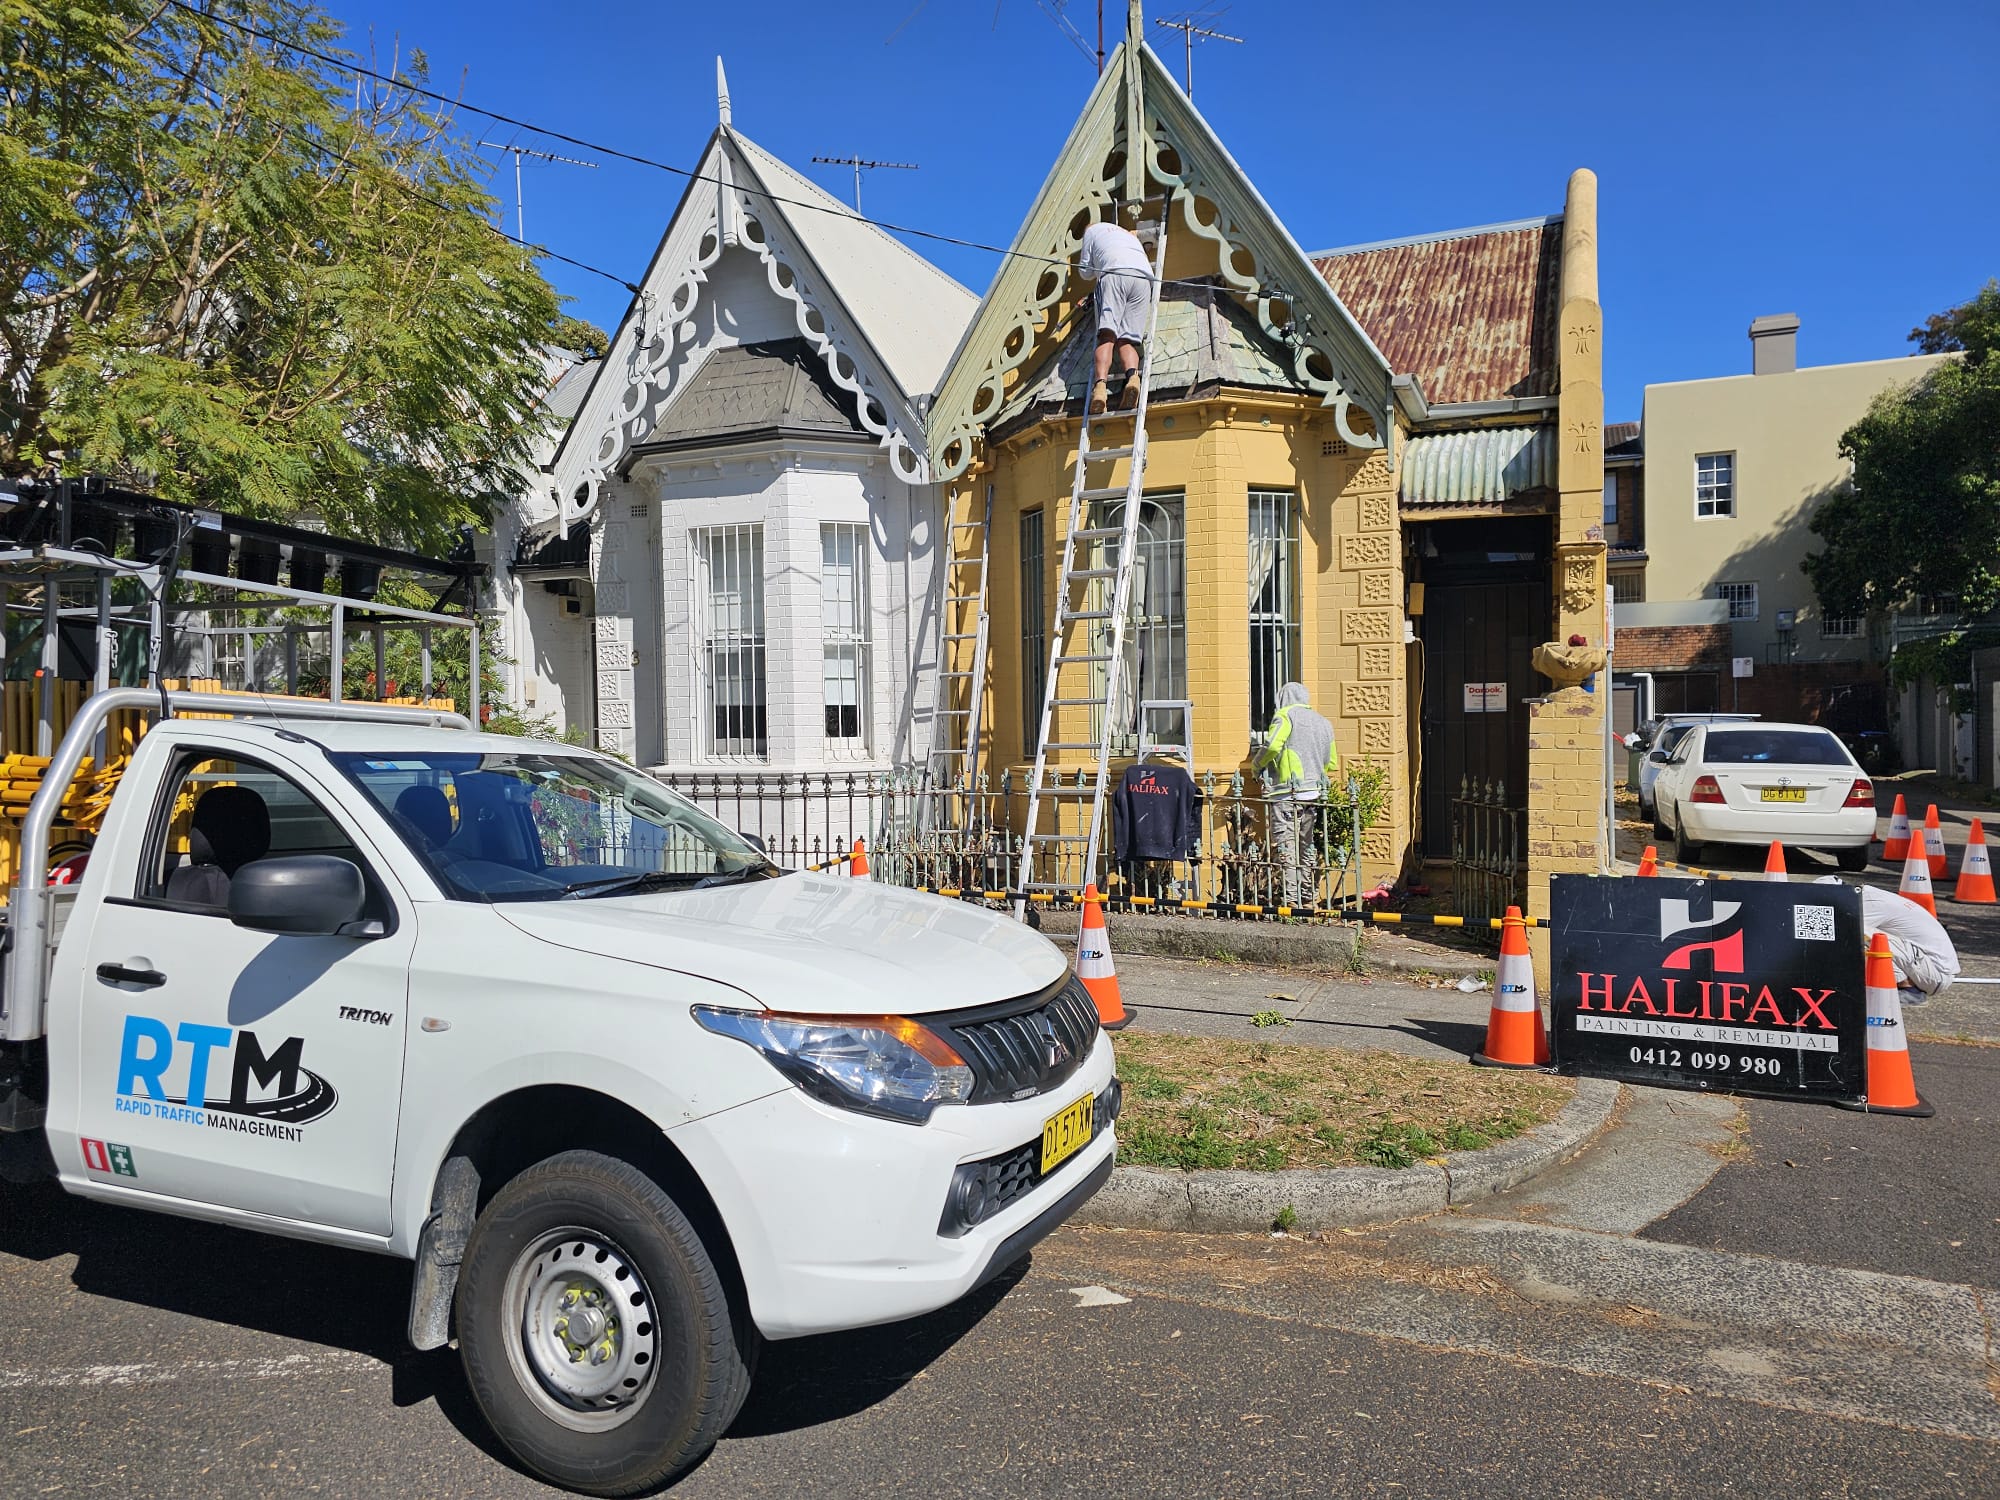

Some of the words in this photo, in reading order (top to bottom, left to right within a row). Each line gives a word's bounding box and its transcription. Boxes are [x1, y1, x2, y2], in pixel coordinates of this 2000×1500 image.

[1081, 950, 1103, 960] RTM
[1501, 984, 1526, 993] RTM
[1576, 972, 1838, 1030] HALIFAX
[339, 1005, 393, 1026] TRITON
[1867, 1016, 1896, 1027] RTM
[1583, 1017, 1682, 1037] PAINTING
[1693, 1027, 1705, 1039] &
[1717, 1028, 1833, 1049] REMEDIAL
[116, 1014, 305, 1108] RTM
[1629, 1046, 1682, 1067] 0412
[1691, 1052, 1731, 1072] 099
[1740, 1056, 1781, 1076] 980
[115, 1097, 151, 1117] RAPID
[154, 1103, 205, 1126] TRAFFIC
[207, 1113, 304, 1143] MANAGEMENT
[1063, 1111, 1076, 1147] 57
